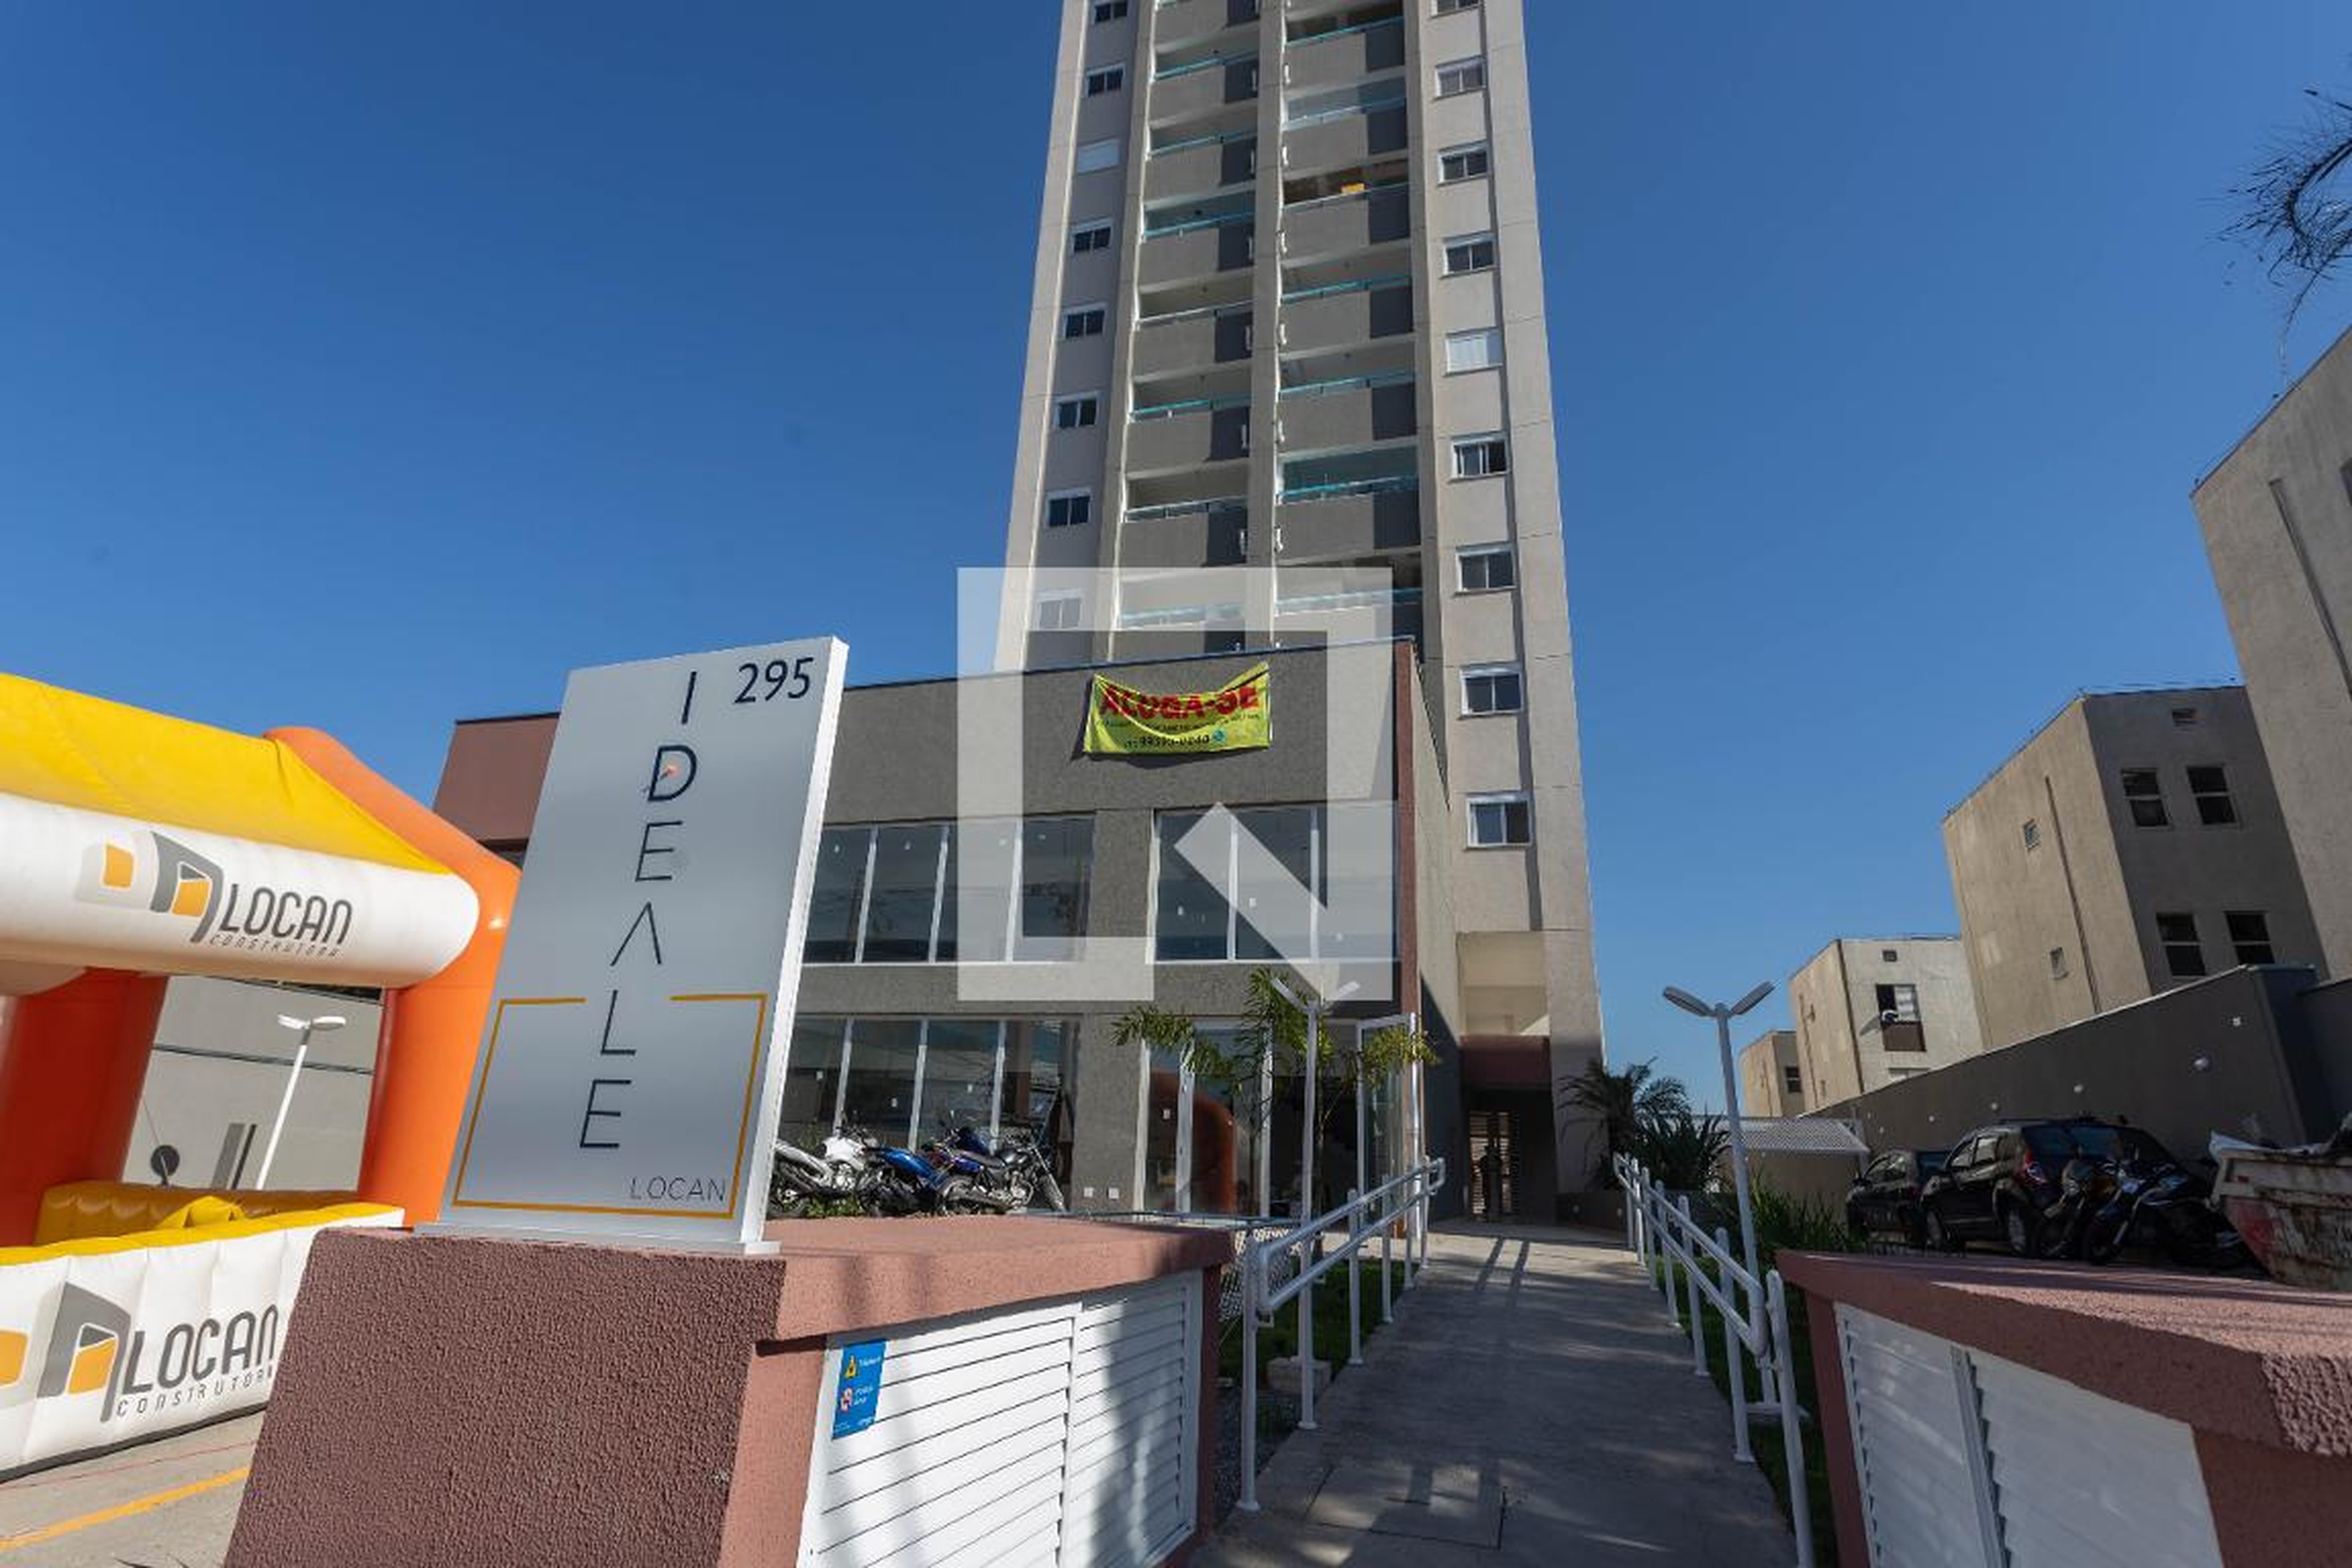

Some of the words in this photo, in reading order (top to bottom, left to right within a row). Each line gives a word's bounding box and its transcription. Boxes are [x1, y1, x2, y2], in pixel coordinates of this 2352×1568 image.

[735, 657, 813, 703] 295
[219, 883, 352, 944] LOCAN
[630, 1176, 726, 1201] LOCAN
[123, 1304, 278, 1395] LOCAN
